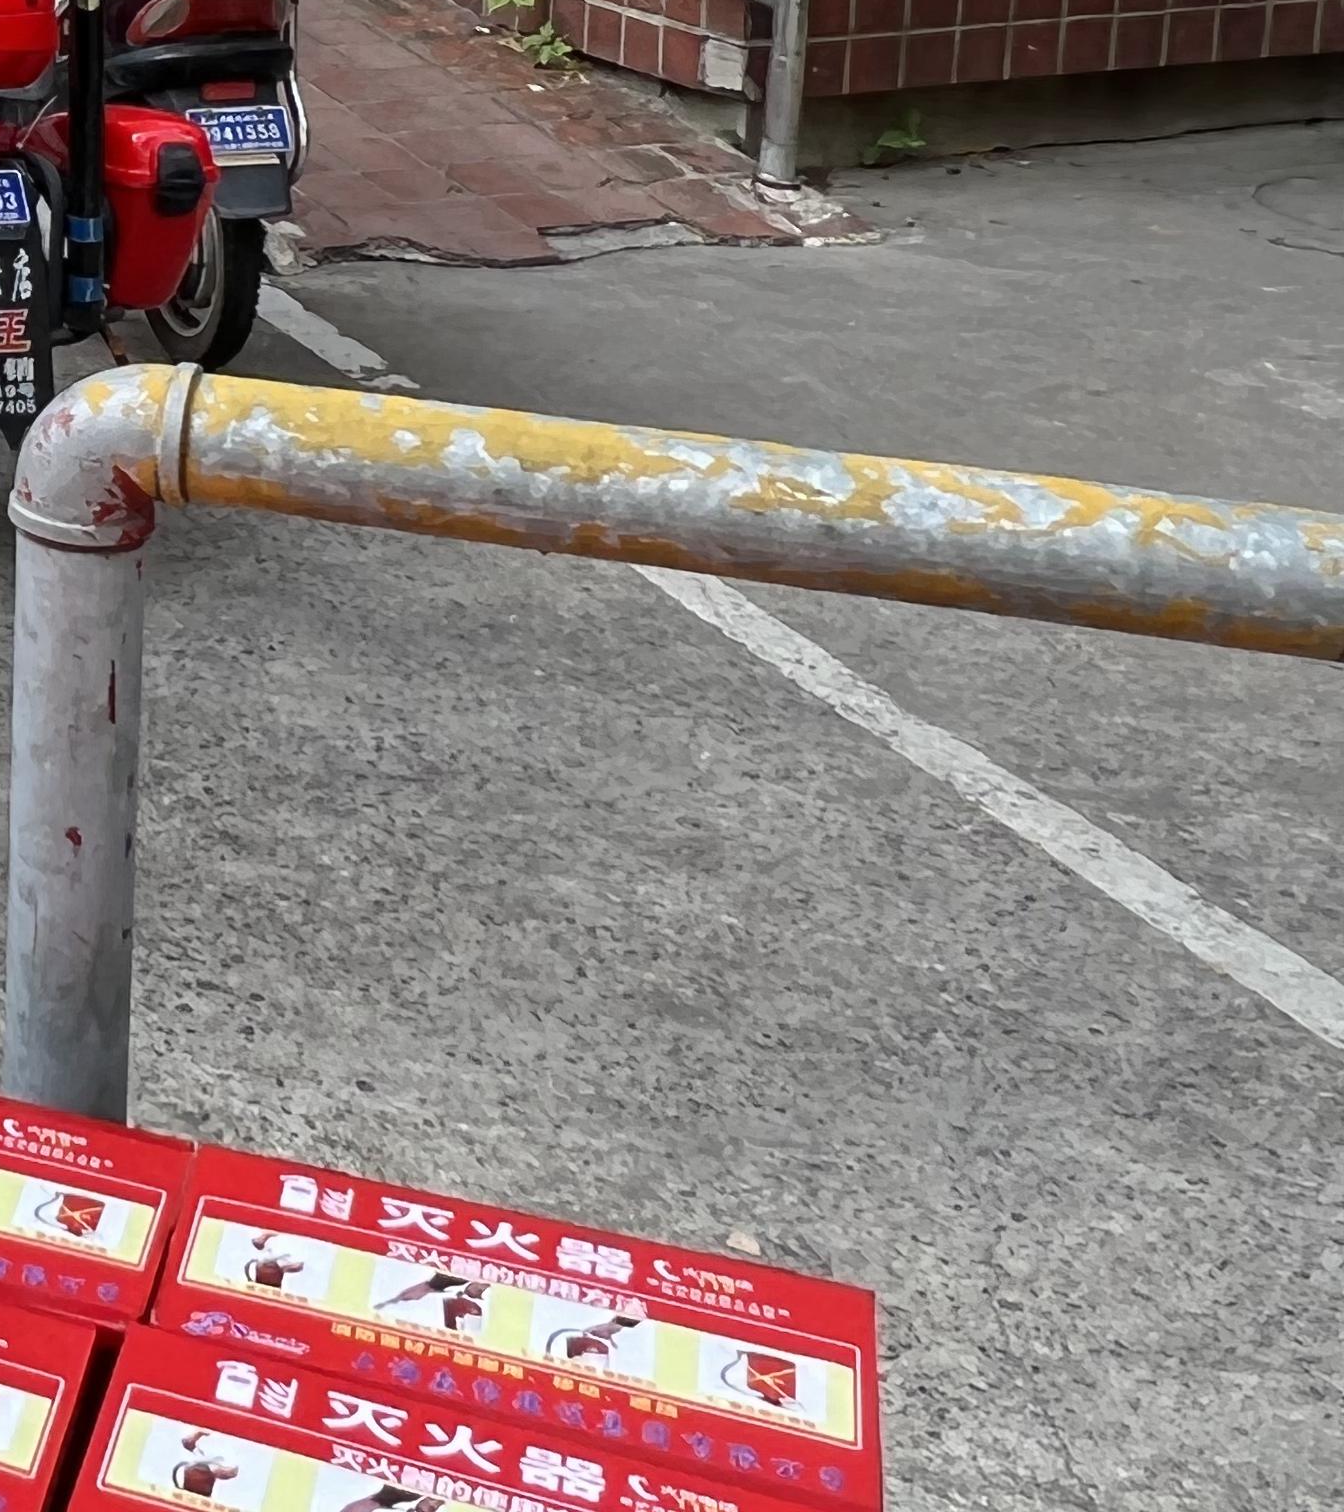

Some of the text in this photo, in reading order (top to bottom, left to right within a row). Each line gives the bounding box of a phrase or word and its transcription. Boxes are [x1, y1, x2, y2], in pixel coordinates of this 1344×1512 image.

[378, 1195, 634, 1285] 灭火器
[322, 1390, 605, 1502] 灭火器
